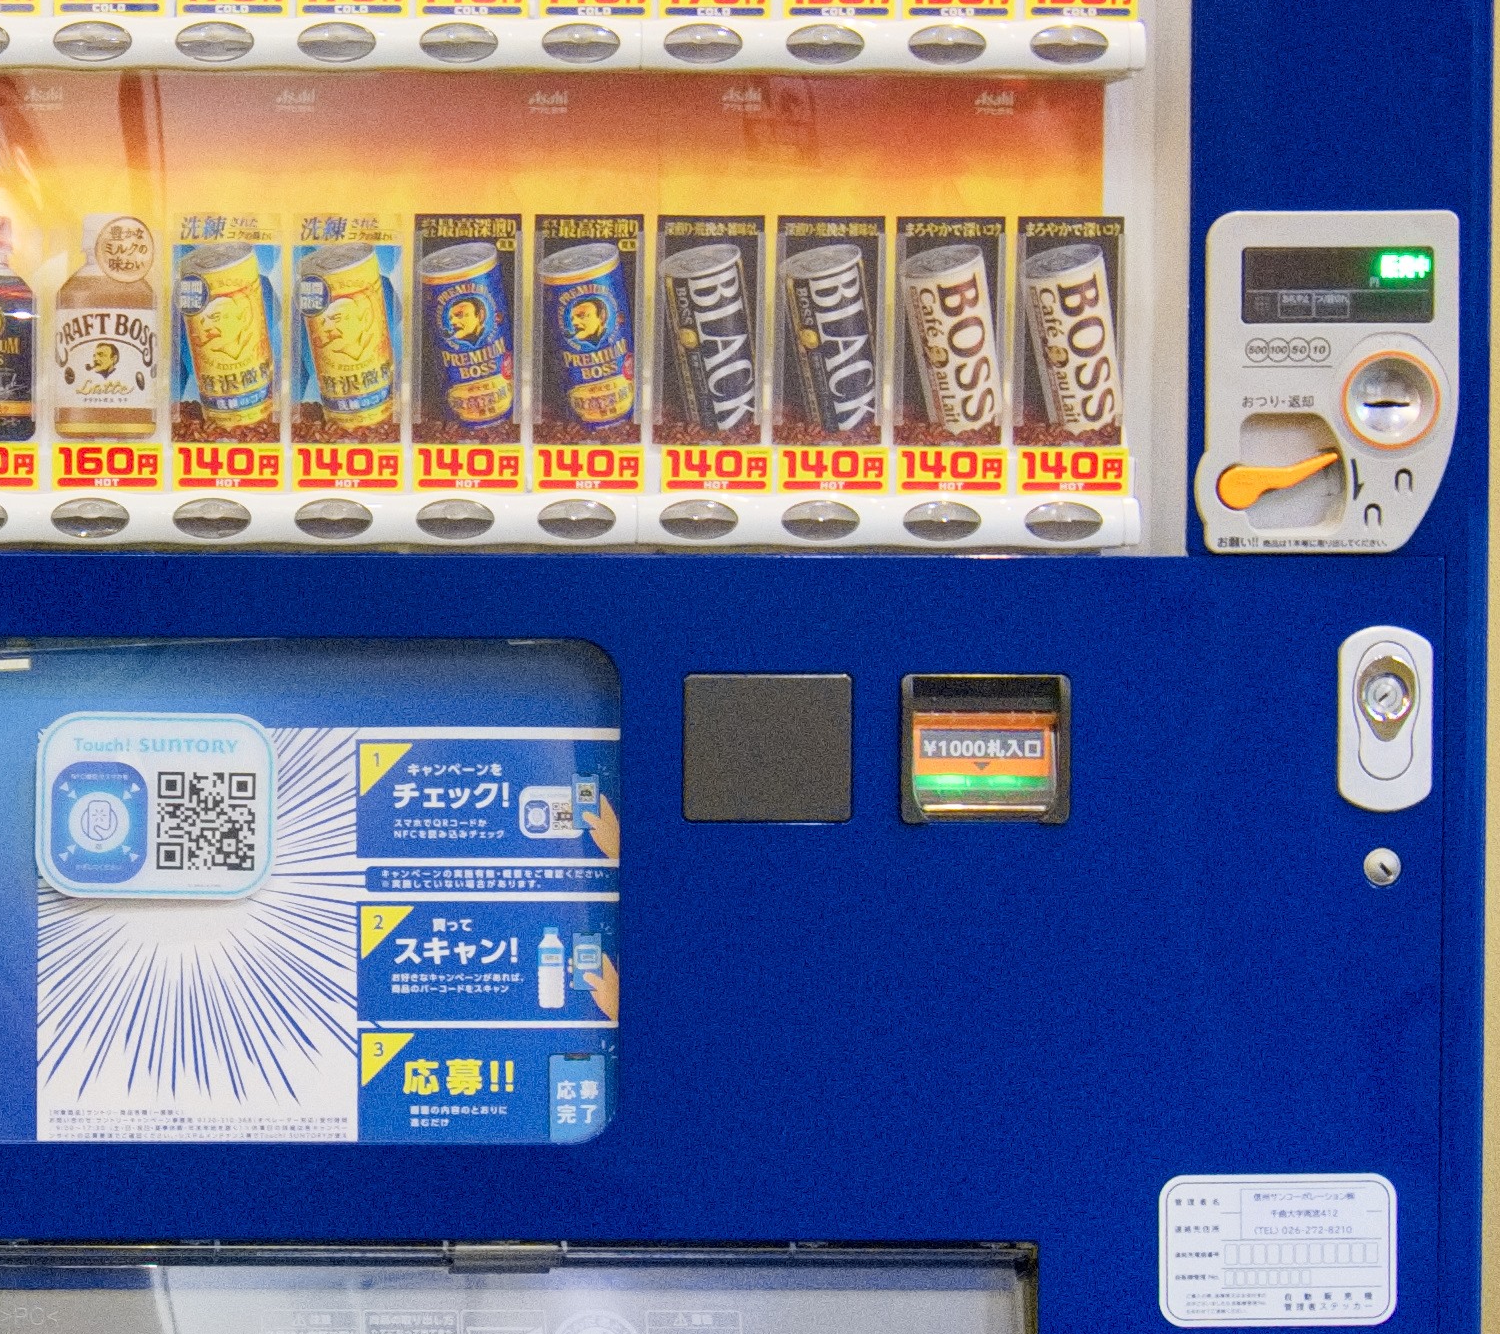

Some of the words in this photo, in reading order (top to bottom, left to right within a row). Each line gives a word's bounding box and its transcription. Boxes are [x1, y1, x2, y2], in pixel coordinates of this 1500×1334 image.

[109, 226, 145, 241] 豊かな
[180, 217, 228, 240] 洗練
[300, 217, 348, 240] 洗練
[438, 218, 517, 239] 最高深煎り
[905, 223, 1003, 238] まろやかで深いコク
[1025, 223, 1122, 238] まろやかで深いコク
[104, 243, 148, 257] ミルクの
[108, 258, 146, 273] 味わい
[55, 313, 111, 368] CRAFT
[114, 315, 158, 368] BOSS
[688, 266, 758, 431] BLACK
[1250, 344, 1268, 355] 500
[1269, 344, 1288, 355] 100
[1291, 344, 1307, 355] 50
[1312, 344, 1326, 355] 10
[919, 288, 945, 338] Café
[941, 394, 960, 425] Lait
[458, 362, 498, 379] BOSS
[580, 362, 619, 379] BOSS
[1241, 395, 1315, 408] おつり・返却
[178, 447, 279, 478] 140円
[297, 447, 399, 478] 140円
[418, 448, 520, 478] 140円
[93, 478, 120, 487] HOT
[73, 736, 132, 754] Touch!
[139, 737, 240, 755] SUNTORY
[922, 737, 1042, 759] ¥1000札入口
[407, 763, 503, 777] キャンペーンを
[393, 782, 510, 809] チェック!
[373, 914, 384, 930] 2
[432, 919, 473, 933] 買って
[393, 937, 519, 965] スキャン!
[373, 1041, 385, 1057] 3
[403, 1058, 515, 1096] 応募!!
[556, 1080, 599, 1100] 応募
[556, 1104, 598, 1125] 完了
